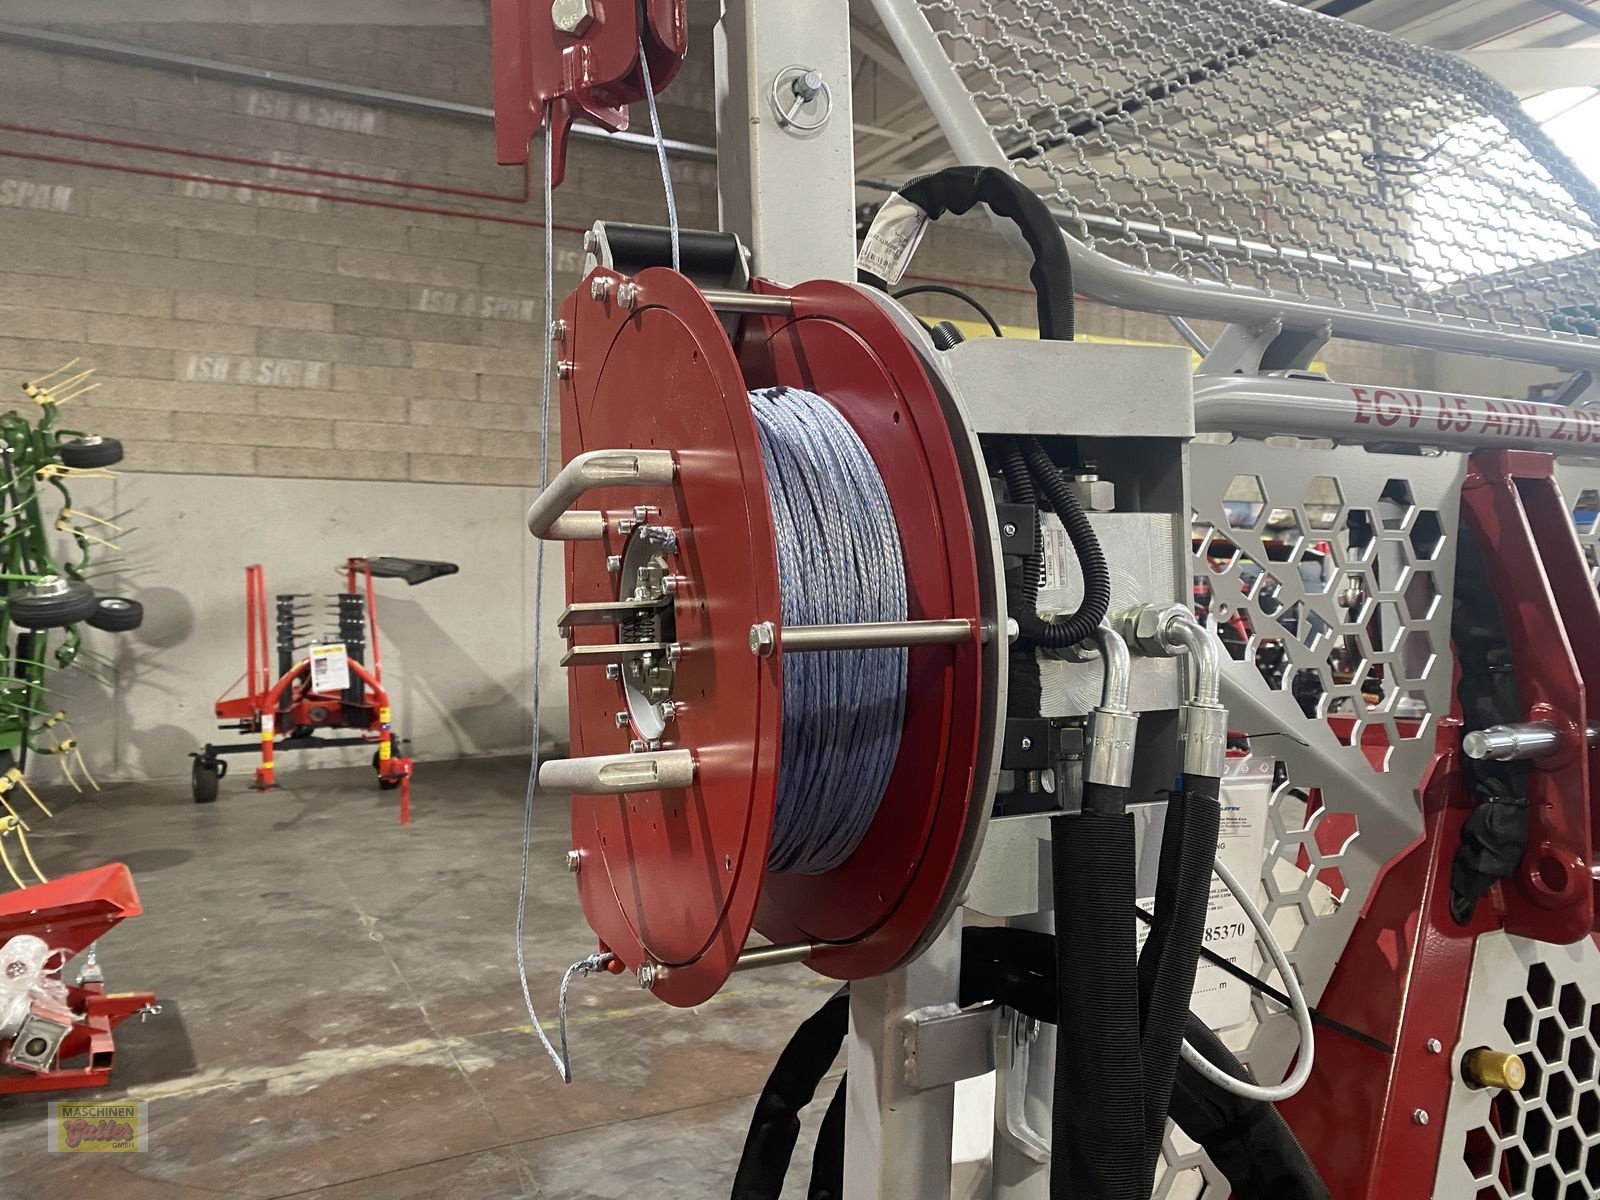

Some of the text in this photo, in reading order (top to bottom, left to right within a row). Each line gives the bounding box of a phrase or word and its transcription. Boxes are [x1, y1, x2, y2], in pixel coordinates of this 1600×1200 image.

[1351, 387, 1422, 428] EGV
[1436, 396, 1472, 432] 65
[1480, 400, 1541, 439] AHK
[1205, 922, 1245, 942] 85370
